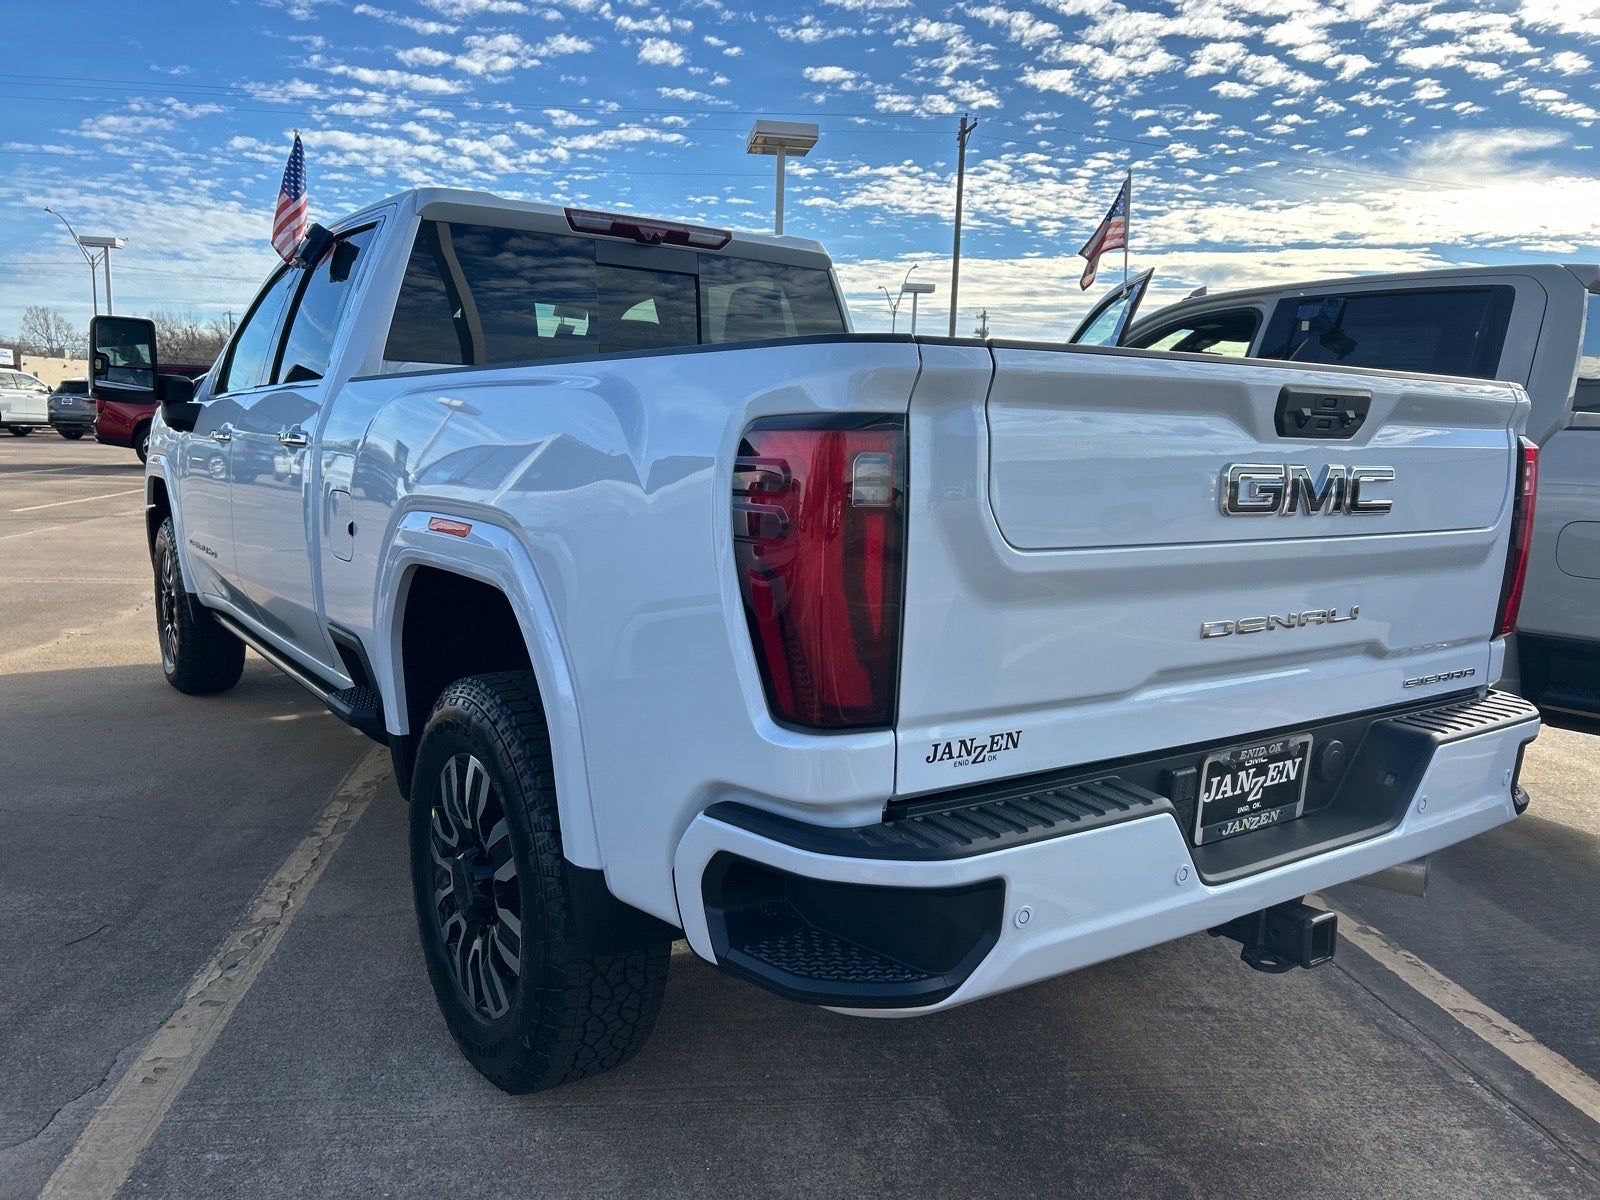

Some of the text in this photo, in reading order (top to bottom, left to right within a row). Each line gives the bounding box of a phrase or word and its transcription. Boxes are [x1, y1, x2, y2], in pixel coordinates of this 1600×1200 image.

[1219, 462, 1395, 517] GMC
[1201, 604, 1360, 640] DENALI
[1403, 667, 1475, 688] SIERRA
[925, 730, 1022, 765] JANZEN
[953, 754, 998, 768] ENID OK
[1269, 742, 1283, 754] OK
[1203, 757, 1302, 802] JANZEN
[1222, 809, 1281, 836] JANZEN
